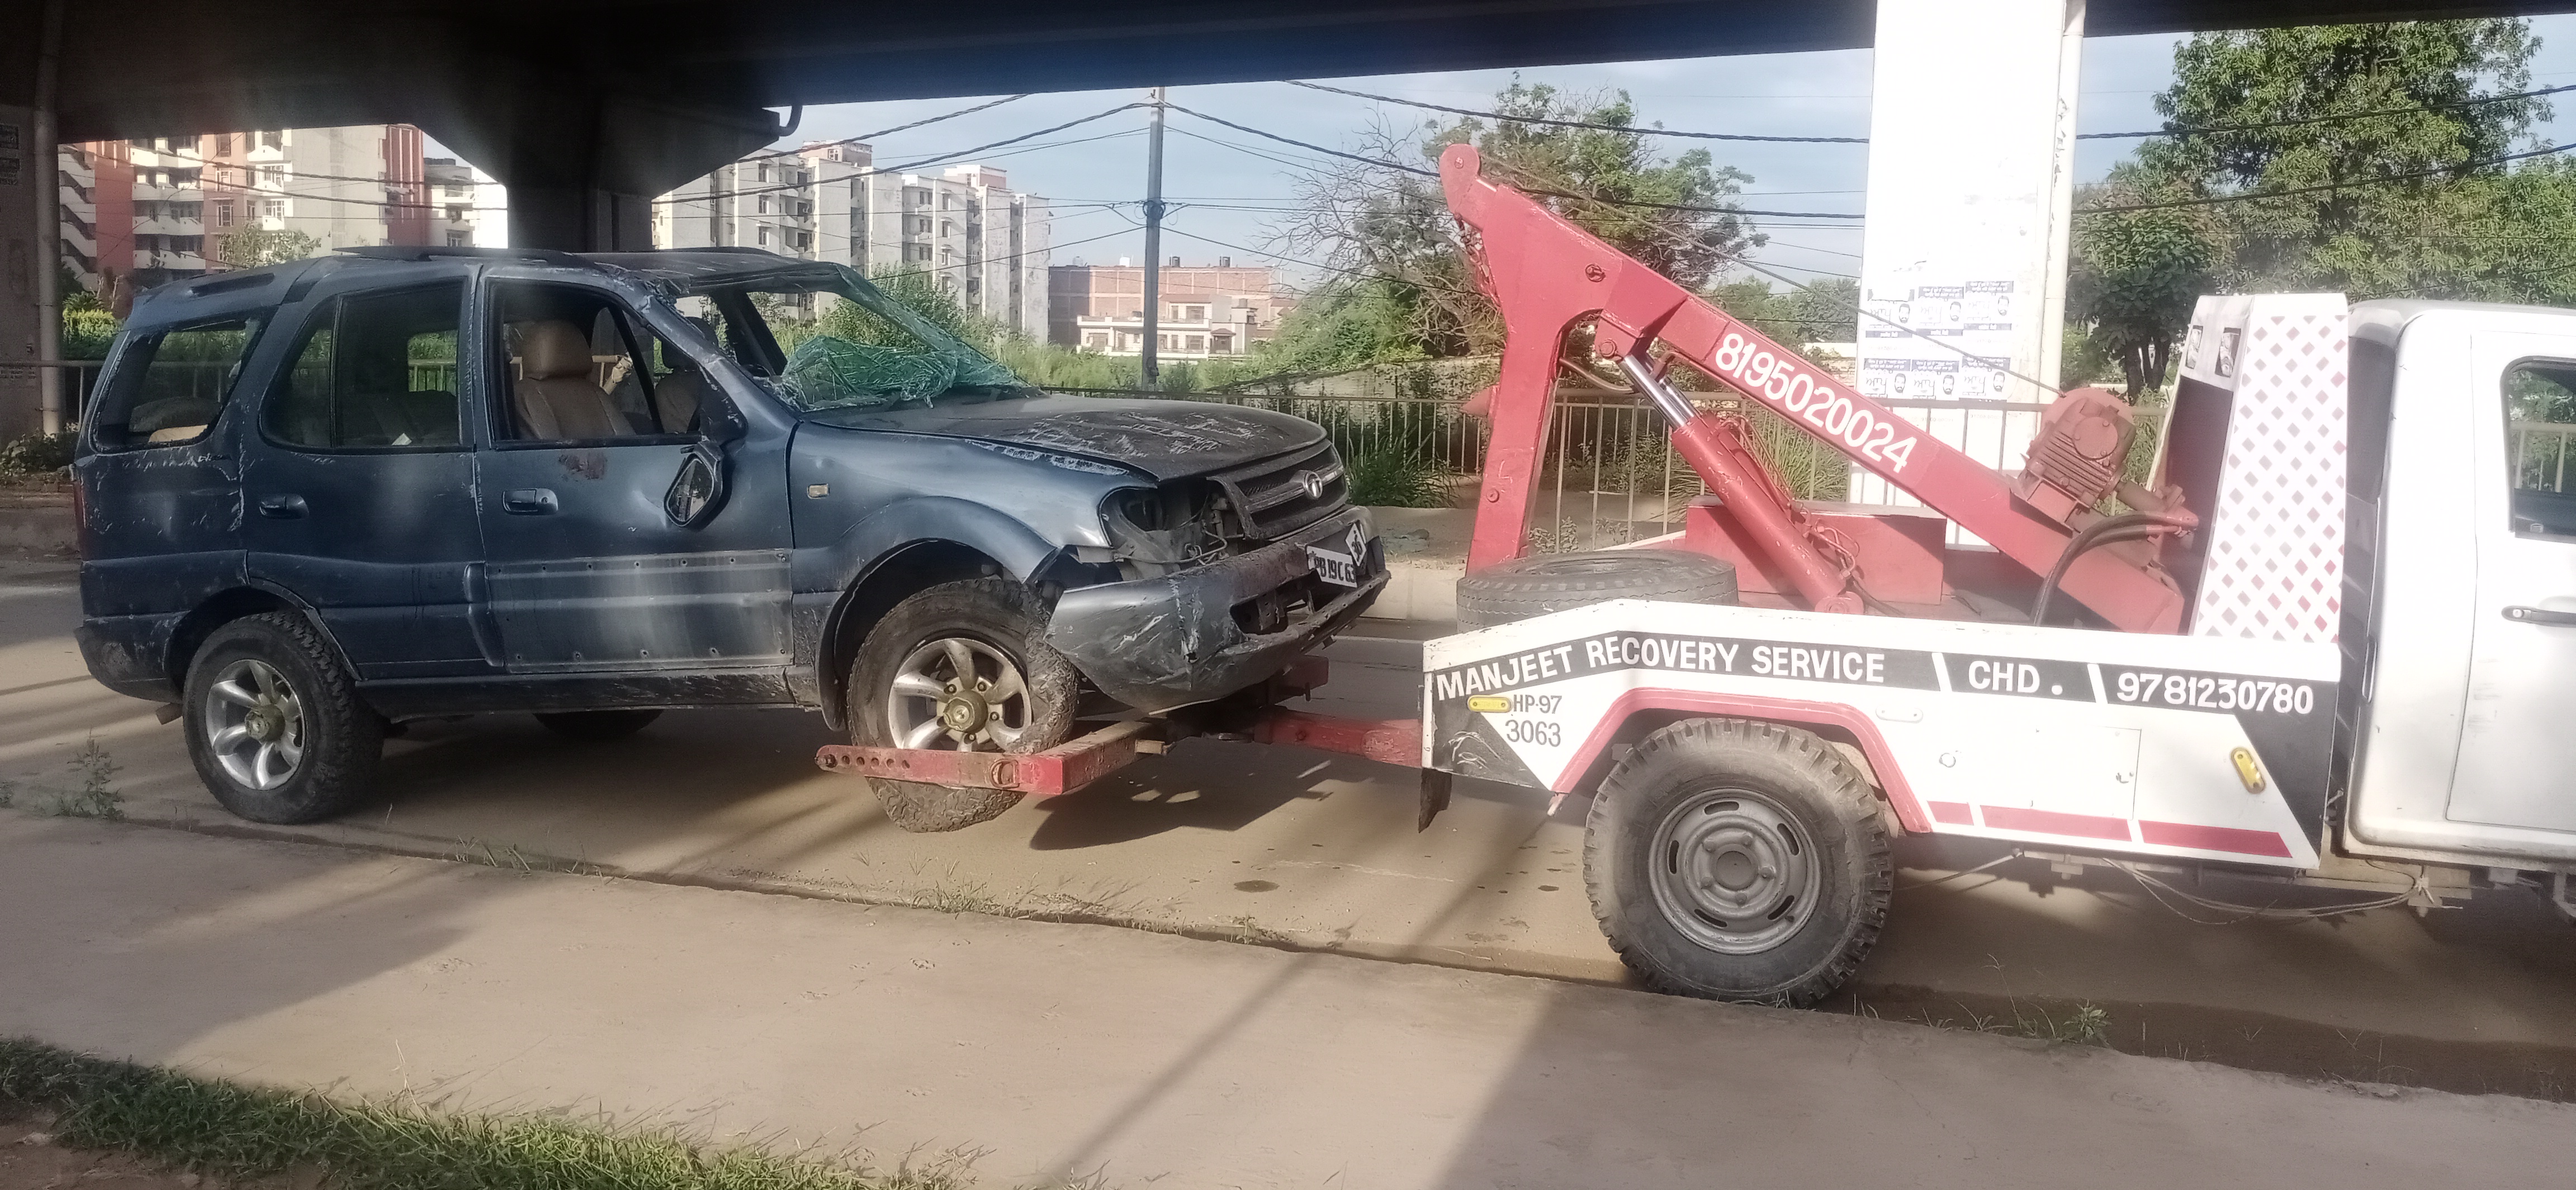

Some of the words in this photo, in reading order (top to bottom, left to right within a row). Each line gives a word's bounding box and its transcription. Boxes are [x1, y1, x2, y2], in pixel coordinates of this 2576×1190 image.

[1715, 333, 1918, 474] 8195020024
[1436, 645, 1573, 701] MANJEET
[1585, 635, 1739, 672] RECOVERY
[1751, 645, 1886, 683] SERVICE
[2116, 672, 2313, 714] 9781230780
[1505, 719, 1561, 747] 3063
